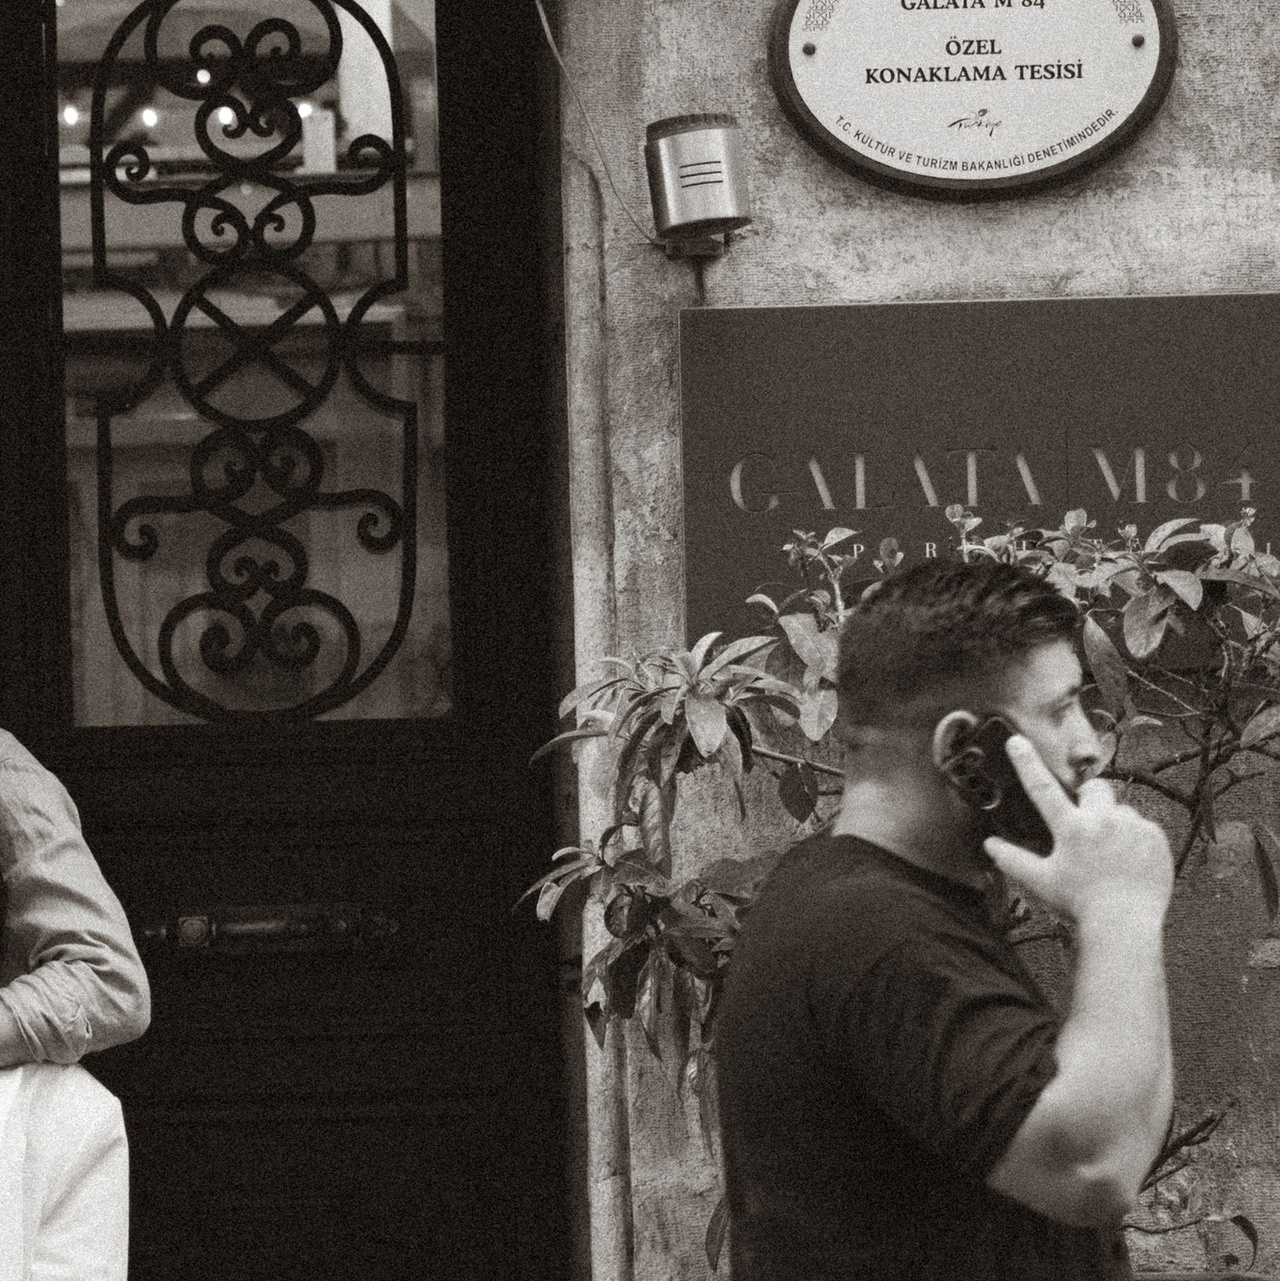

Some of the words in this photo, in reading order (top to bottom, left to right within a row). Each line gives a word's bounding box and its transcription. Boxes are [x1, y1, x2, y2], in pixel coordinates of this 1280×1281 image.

[945, 35, 1002, 56] ÖZEL
[865, 66, 1007, 84] KONAKLAMA
[1014, 58, 1084, 81] TESİSİ
[898, 151, 914, 163] VE
